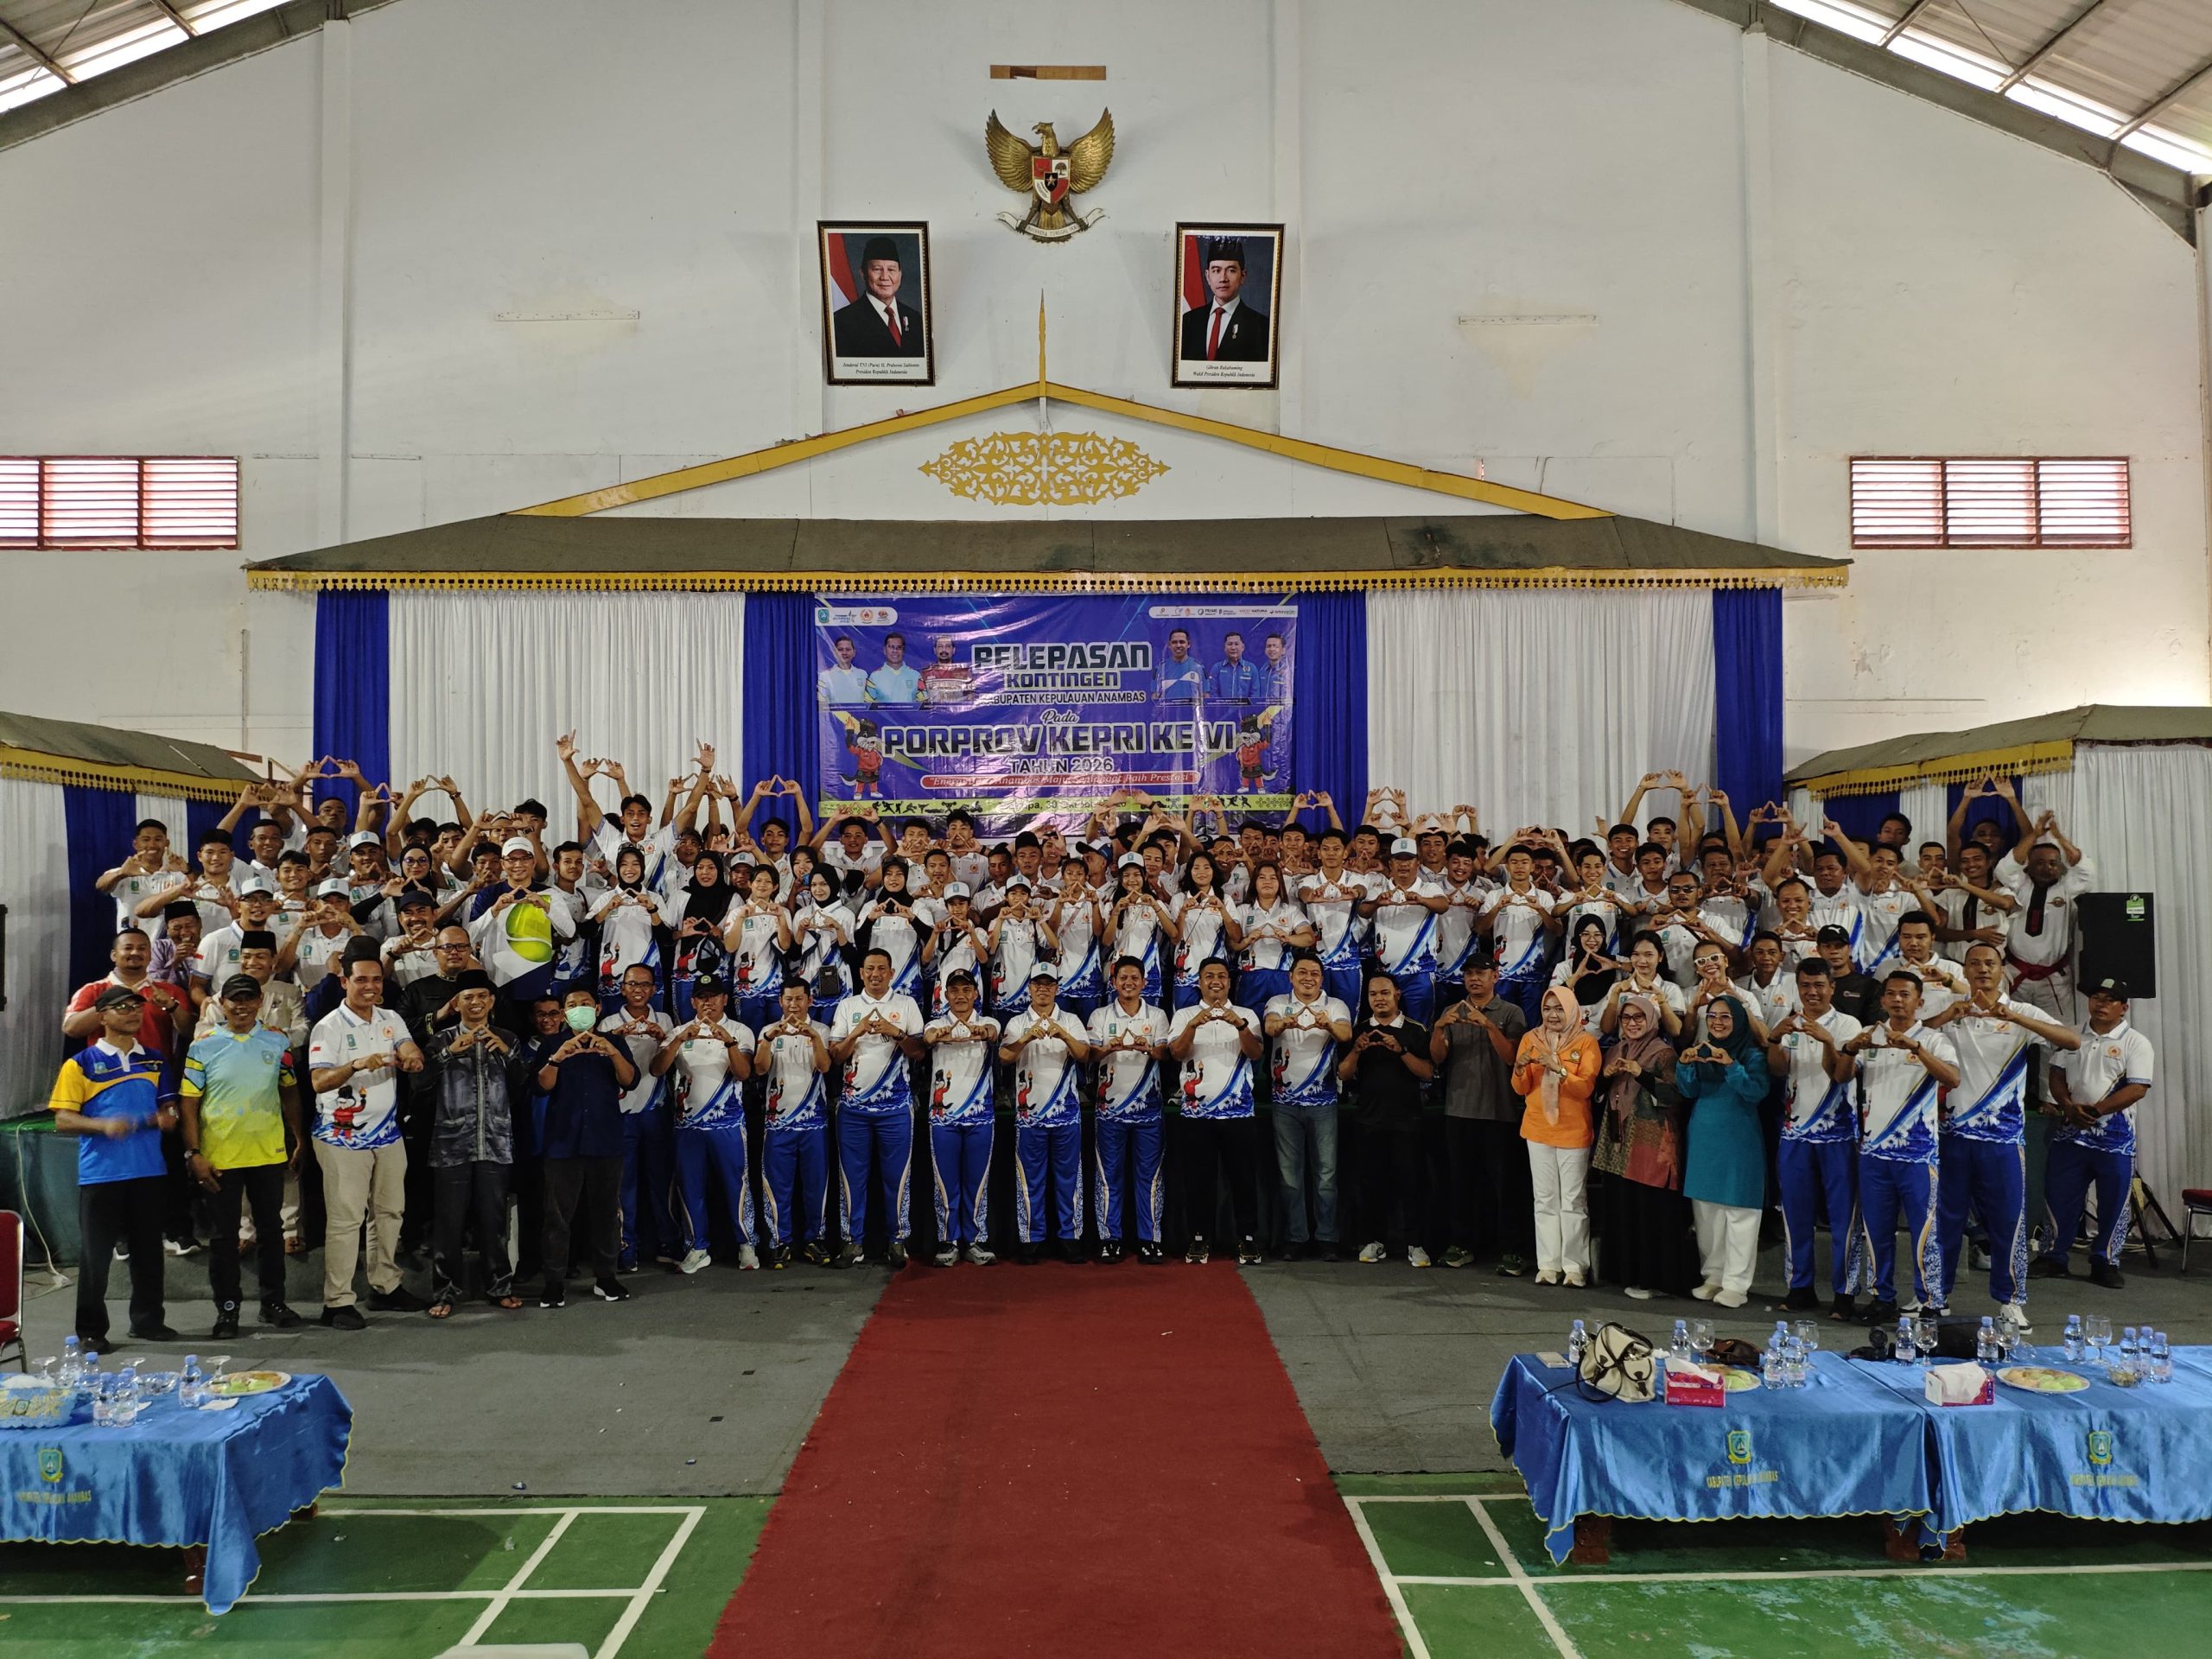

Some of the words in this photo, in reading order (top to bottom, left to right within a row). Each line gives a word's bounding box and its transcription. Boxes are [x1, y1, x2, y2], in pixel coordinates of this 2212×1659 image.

[974, 644, 1150, 671] PELEPASAN
[1007, 671, 1119, 689] KONTINGEN
[979, 693, 1037, 705] BUPATEN
[1039, 692, 1097, 704] KEPULAUAN
[1098, 691, 1146, 703] ANAMBAS
[1041, 709, 1079, 724] Pada
[883, 727, 1041, 754] PORPROV
[1048, 723, 1144, 753] KEPRI
[1152, 723, 1194, 751] KE
[1205, 722, 1234, 750] VI
[1009, 758, 1068, 774] TAHUN
[1071, 758, 1114, 772] 2026
